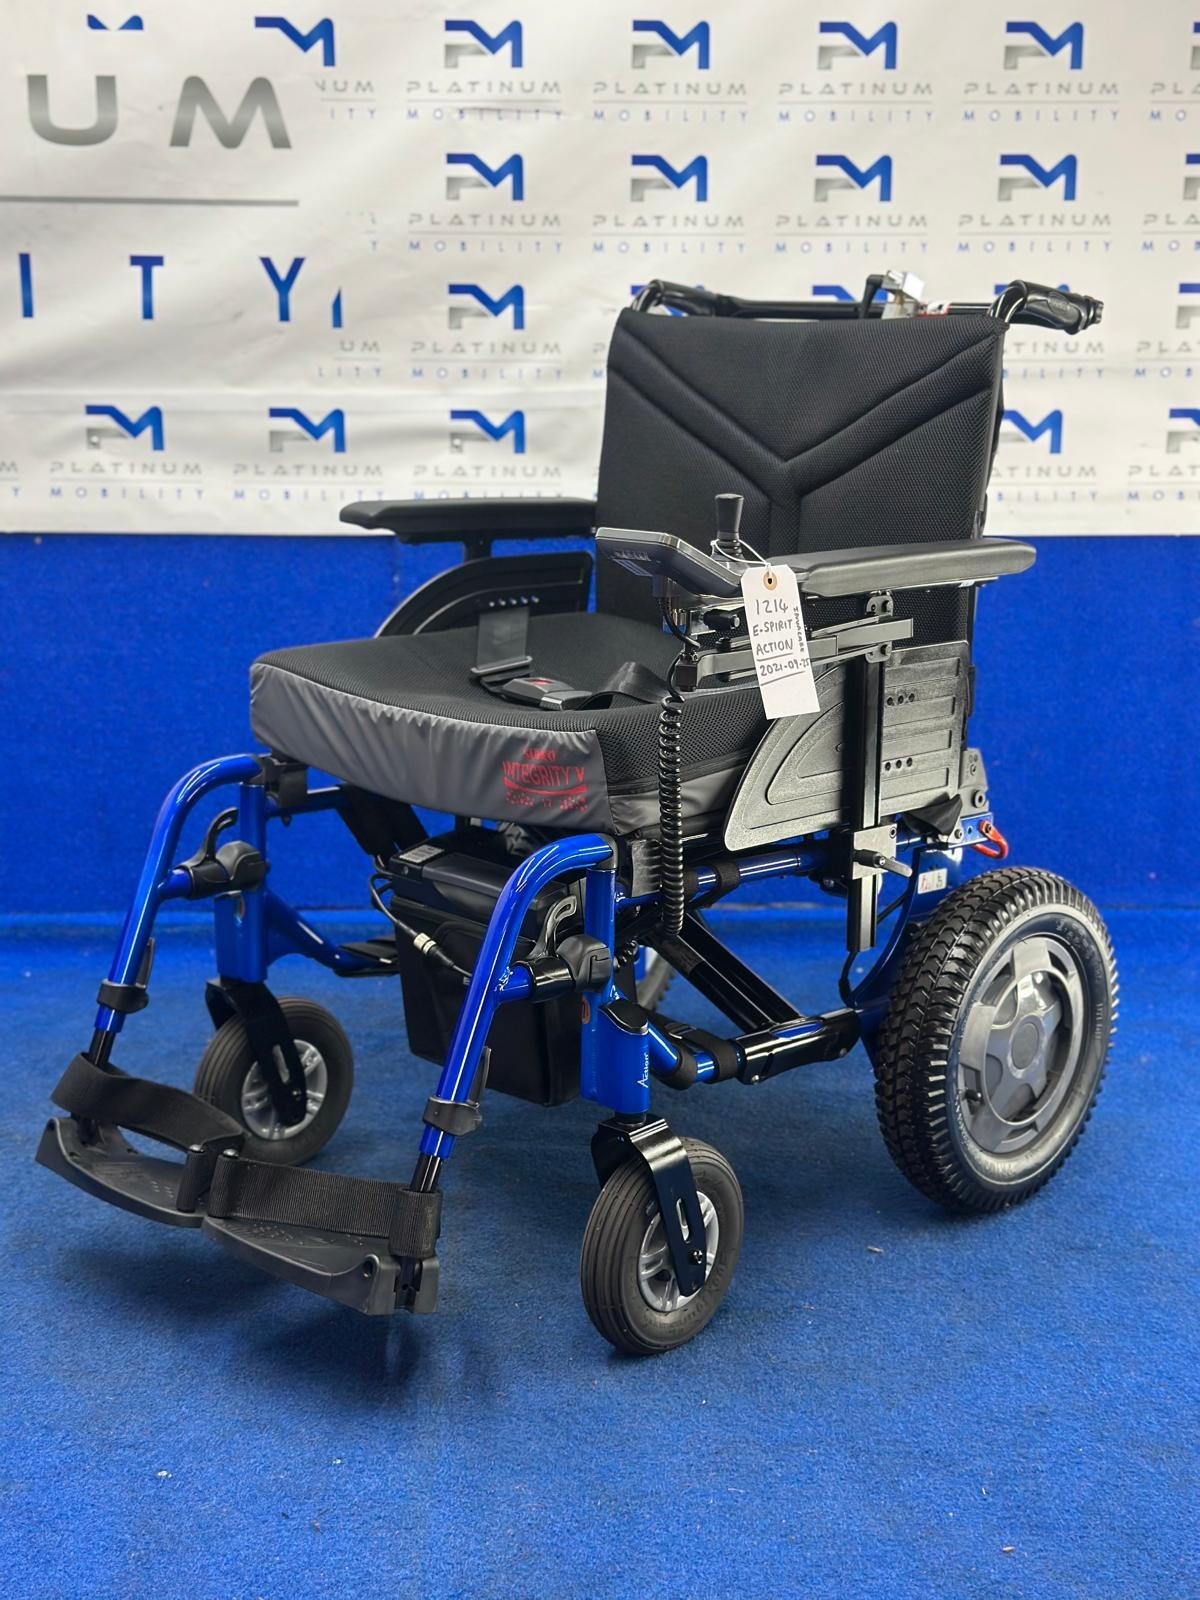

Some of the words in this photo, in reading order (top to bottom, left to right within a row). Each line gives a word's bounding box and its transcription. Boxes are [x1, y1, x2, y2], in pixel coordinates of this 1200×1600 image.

[406, 81, 561, 94] PLATINUM
[593, 82, 747, 95] PLATINUM
[778, 82, 932, 95] PLATINUM
[964, 82, 1118, 95] PLATINUM
[407, 108, 561, 121] MOBILITY
[593, 110, 747, 122] MOBILITY
[779, 110, 932, 122] MOBILITY
[964, 109, 1118, 122] MOBILITY
[408, 214, 561, 226] PLATINUM
[593, 215, 744, 227] PLATINUM
[776, 215, 927, 227] PLATINUM
[958, 214, 1111, 227] PLATINUM
[409, 241, 562, 252] MOBILITY
[593, 241, 745, 253] MOBILITY
[776, 241, 927, 253] MOBILITY
[958, 241, 1111, 252] MOBILITY
[411, 340, 561, 353] PLATINUM
[412, 367, 563, 378] MOBILITY
[50, 461, 202, 475] PLATINUM
[234, 464, 382, 476] PLATINUM
[413, 465, 561, 478] PLATINUM
[50, 486, 203, 498] MOBILITY
[234, 489, 384, 501] MOBILITY
[756, 598, 789, 616] 1214
[756, 638, 794, 656] ACTION
